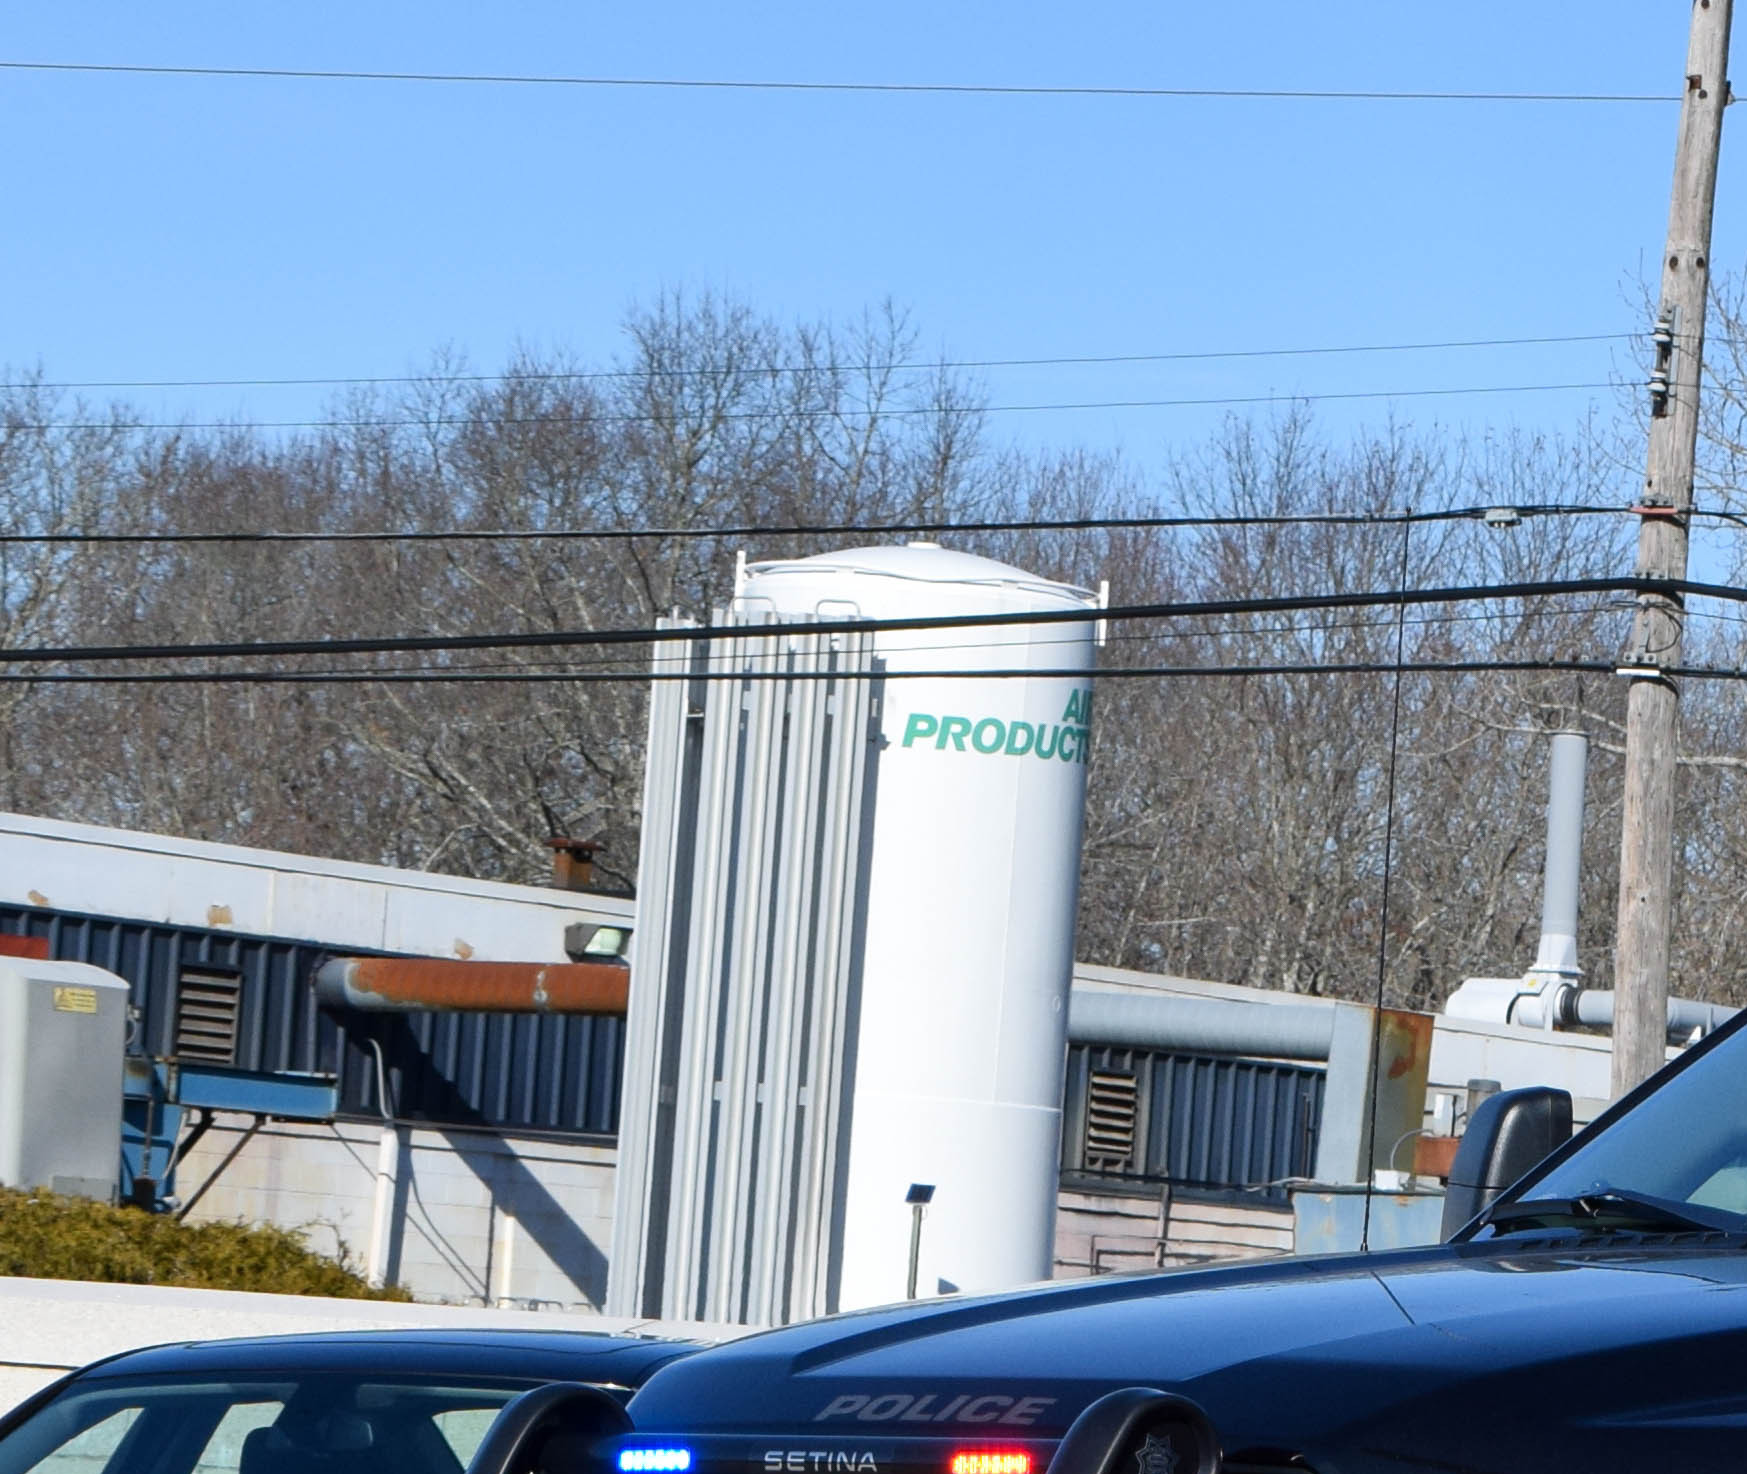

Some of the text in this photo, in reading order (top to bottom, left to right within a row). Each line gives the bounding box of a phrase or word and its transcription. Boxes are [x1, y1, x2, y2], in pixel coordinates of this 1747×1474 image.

[1062, 688, 1094, 726] AI
[814, 1394, 1057, 1425] POLICE
[763, 1450, 878, 1474] SETINA
